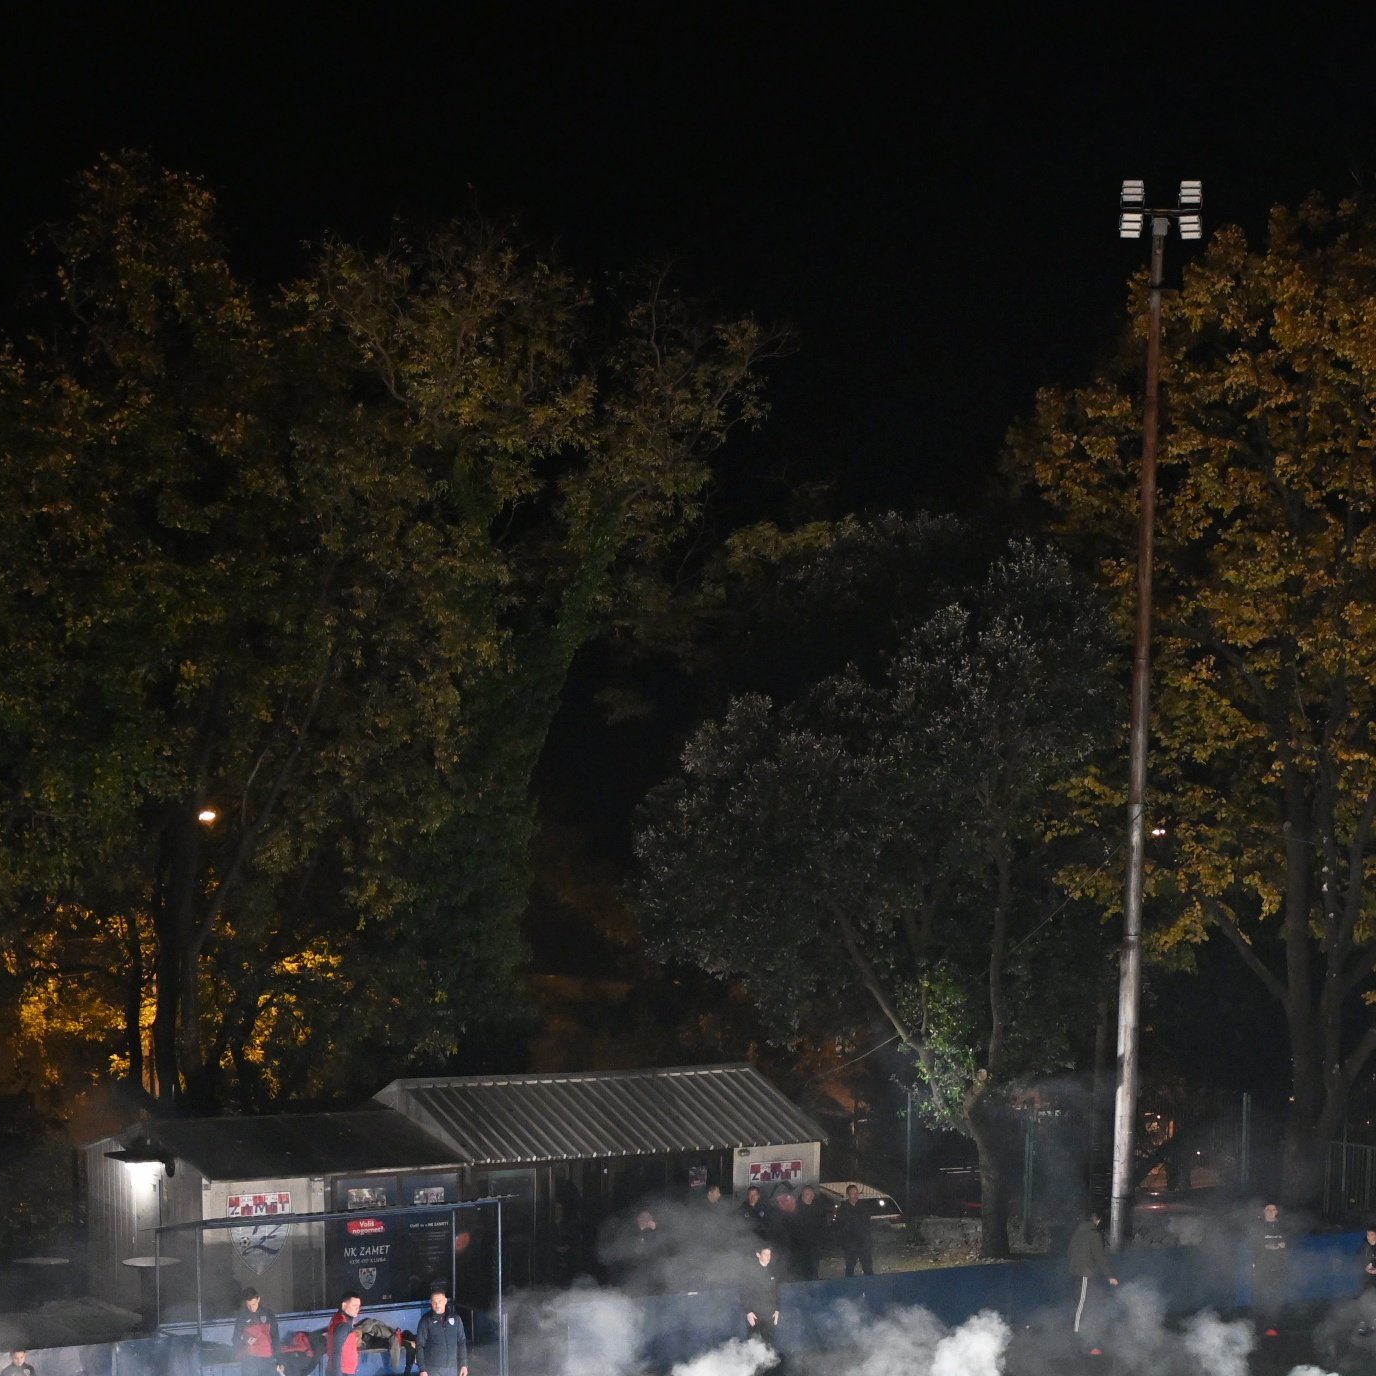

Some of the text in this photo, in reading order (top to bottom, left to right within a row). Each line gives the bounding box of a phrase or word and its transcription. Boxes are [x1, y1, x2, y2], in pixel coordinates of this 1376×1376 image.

[750, 1168, 801, 1181] ZAMET
[228, 1201, 290, 1216] ZAMET
[352, 1226, 384, 1235] nogomet?
[359, 1220, 374, 1228] Voliš
[344, 1244, 391, 1257] NK ZAMET
